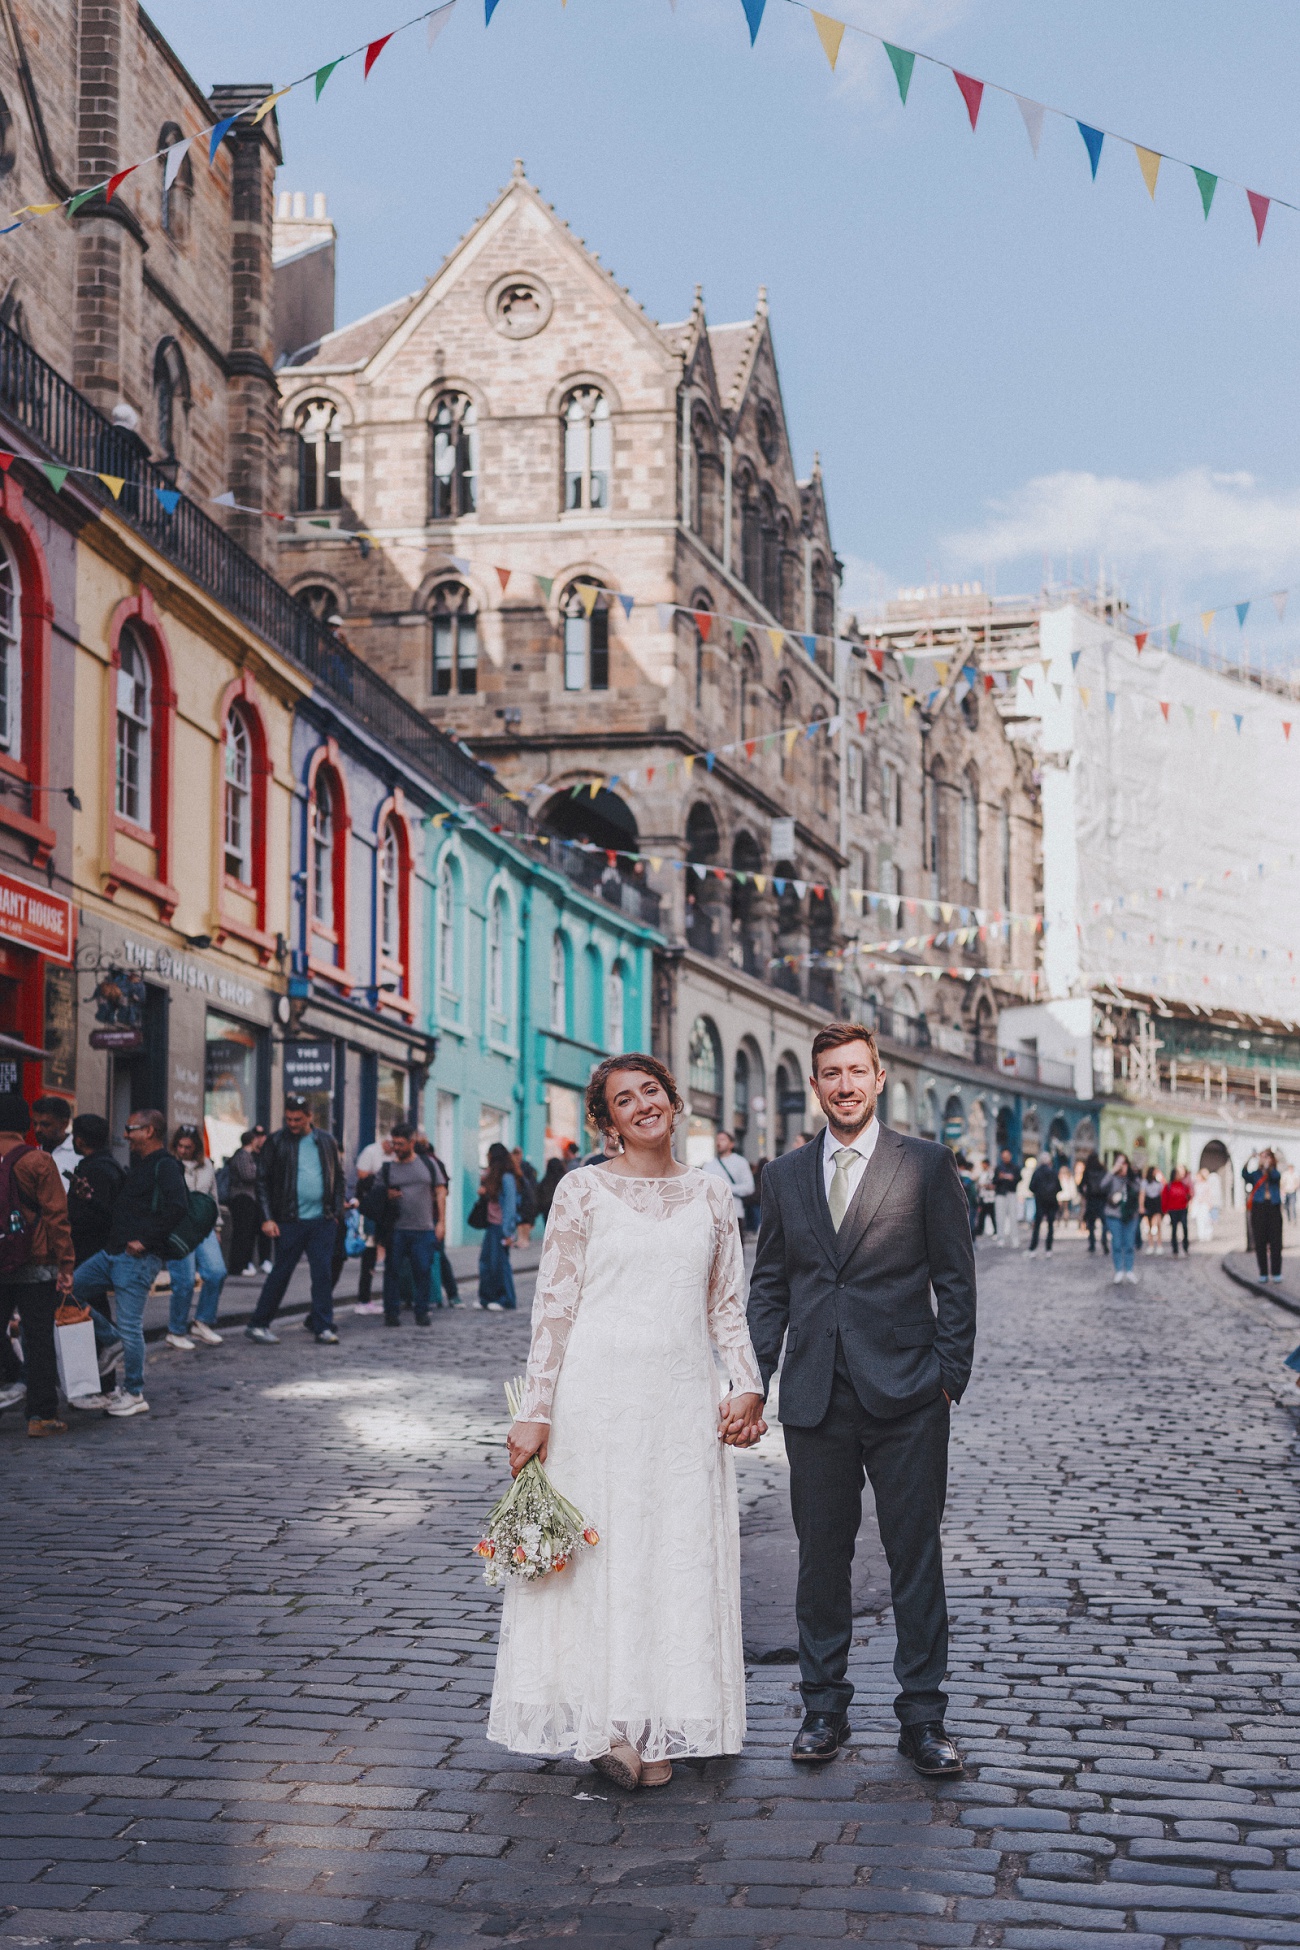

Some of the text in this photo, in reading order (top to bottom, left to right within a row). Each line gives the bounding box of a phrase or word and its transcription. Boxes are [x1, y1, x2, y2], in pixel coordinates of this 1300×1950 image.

[0, 886, 64, 936] ANT HOUSE
[124, 940, 255, 1006] THE WHISKY SHOP
[297, 1048, 319, 1058] THE
[286, 1062, 330, 1073] WHISKY
[293, 1076, 322, 1087] SHOP
